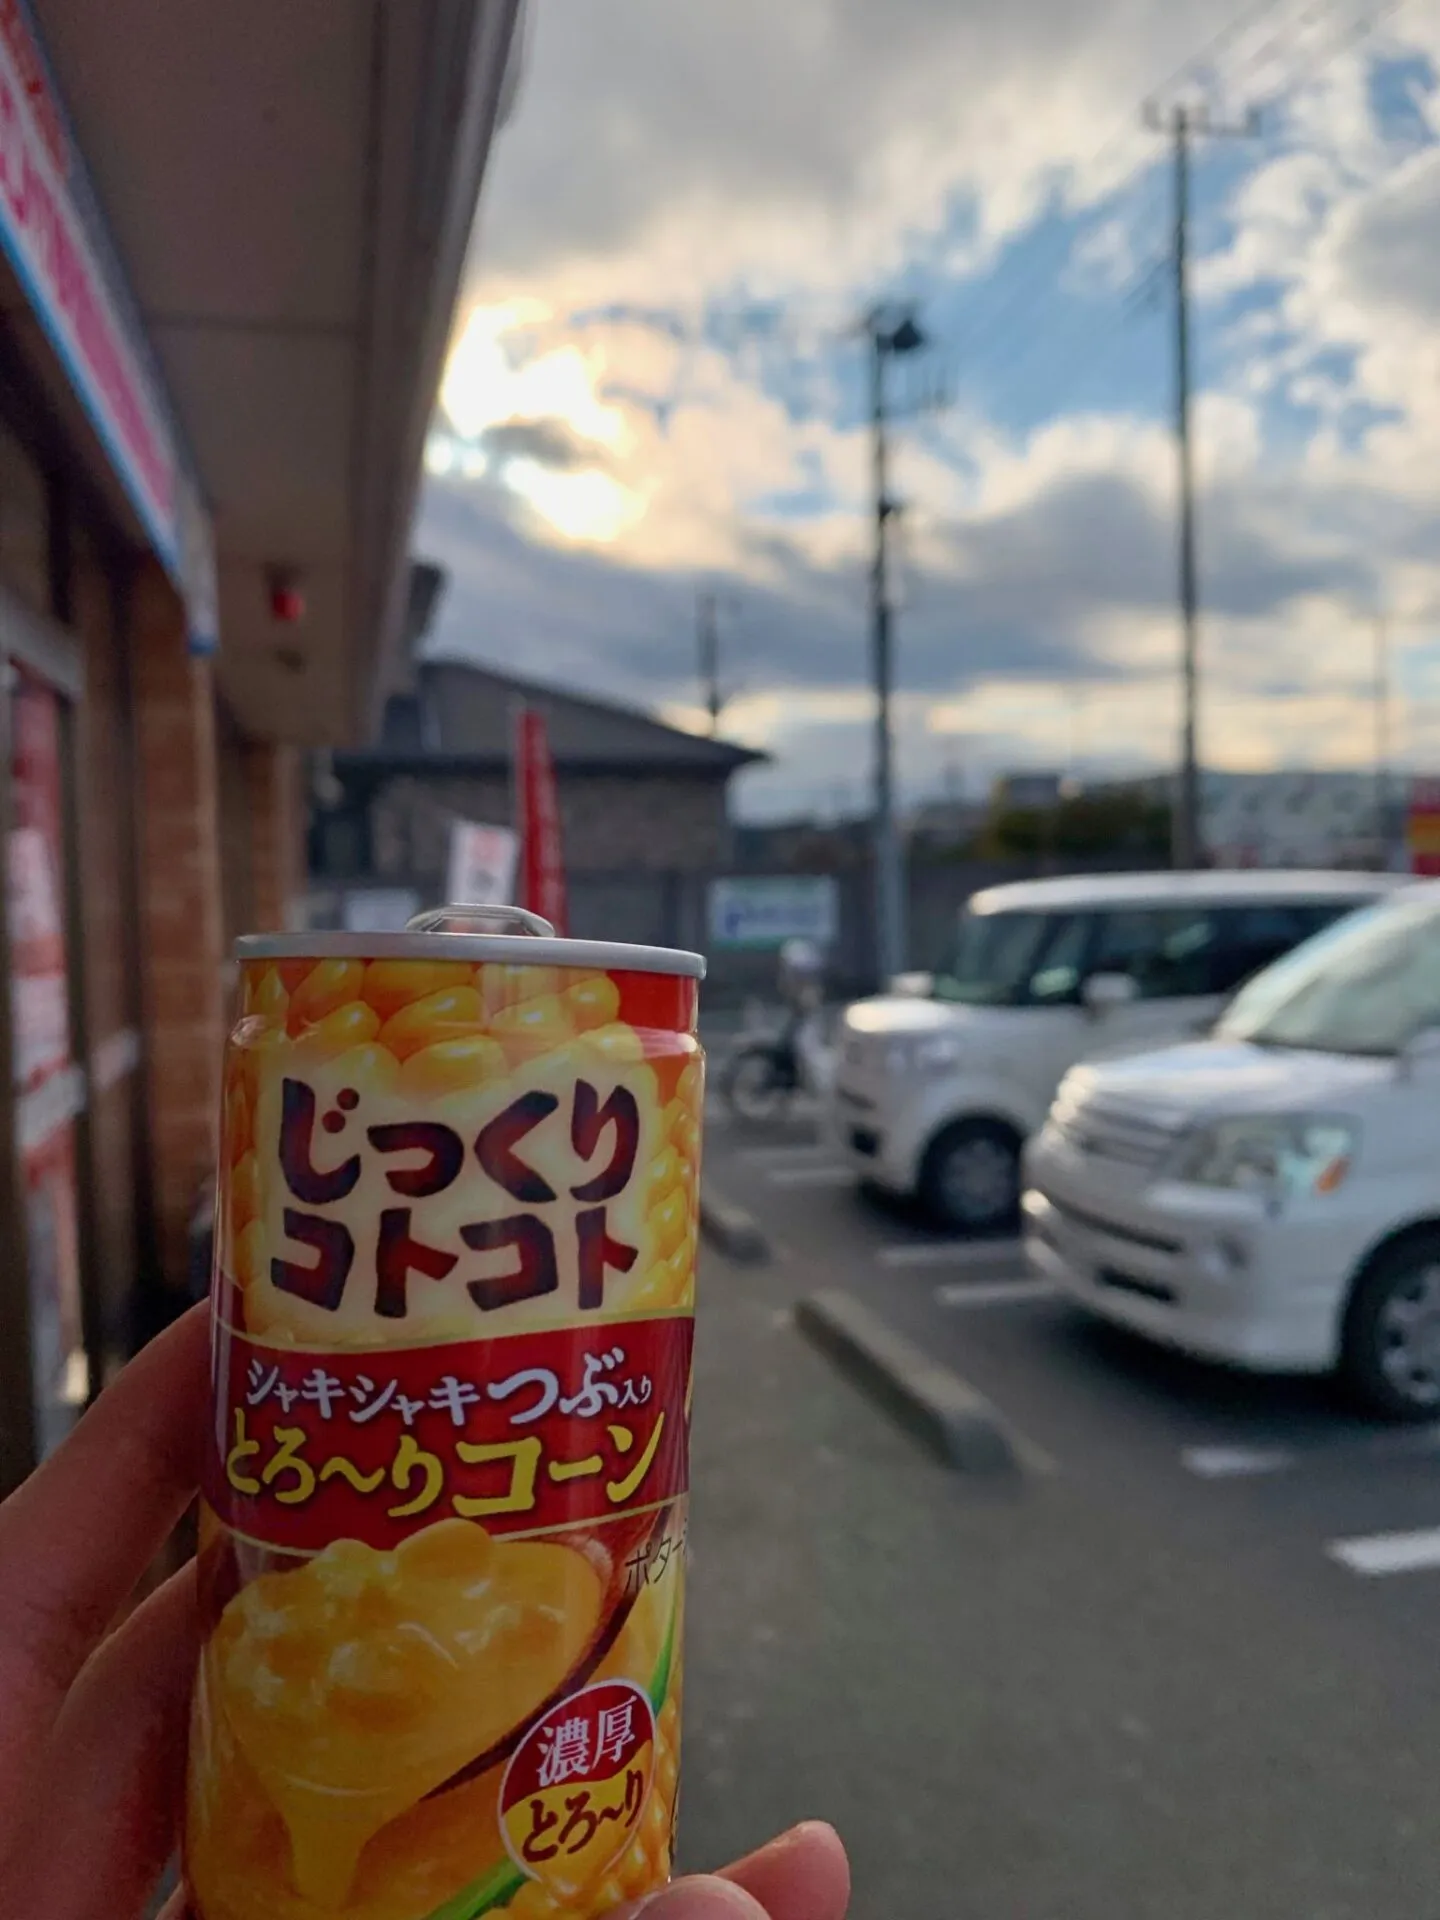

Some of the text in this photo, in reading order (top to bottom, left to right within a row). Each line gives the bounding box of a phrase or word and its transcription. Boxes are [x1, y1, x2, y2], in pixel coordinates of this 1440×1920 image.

[279, 1077, 640, 1203] じっくり
[270, 1207, 639, 1318] コトコト
[623, 1517, 686, 1596] ポター
[535, 1696, 638, 1786] 濃厚
